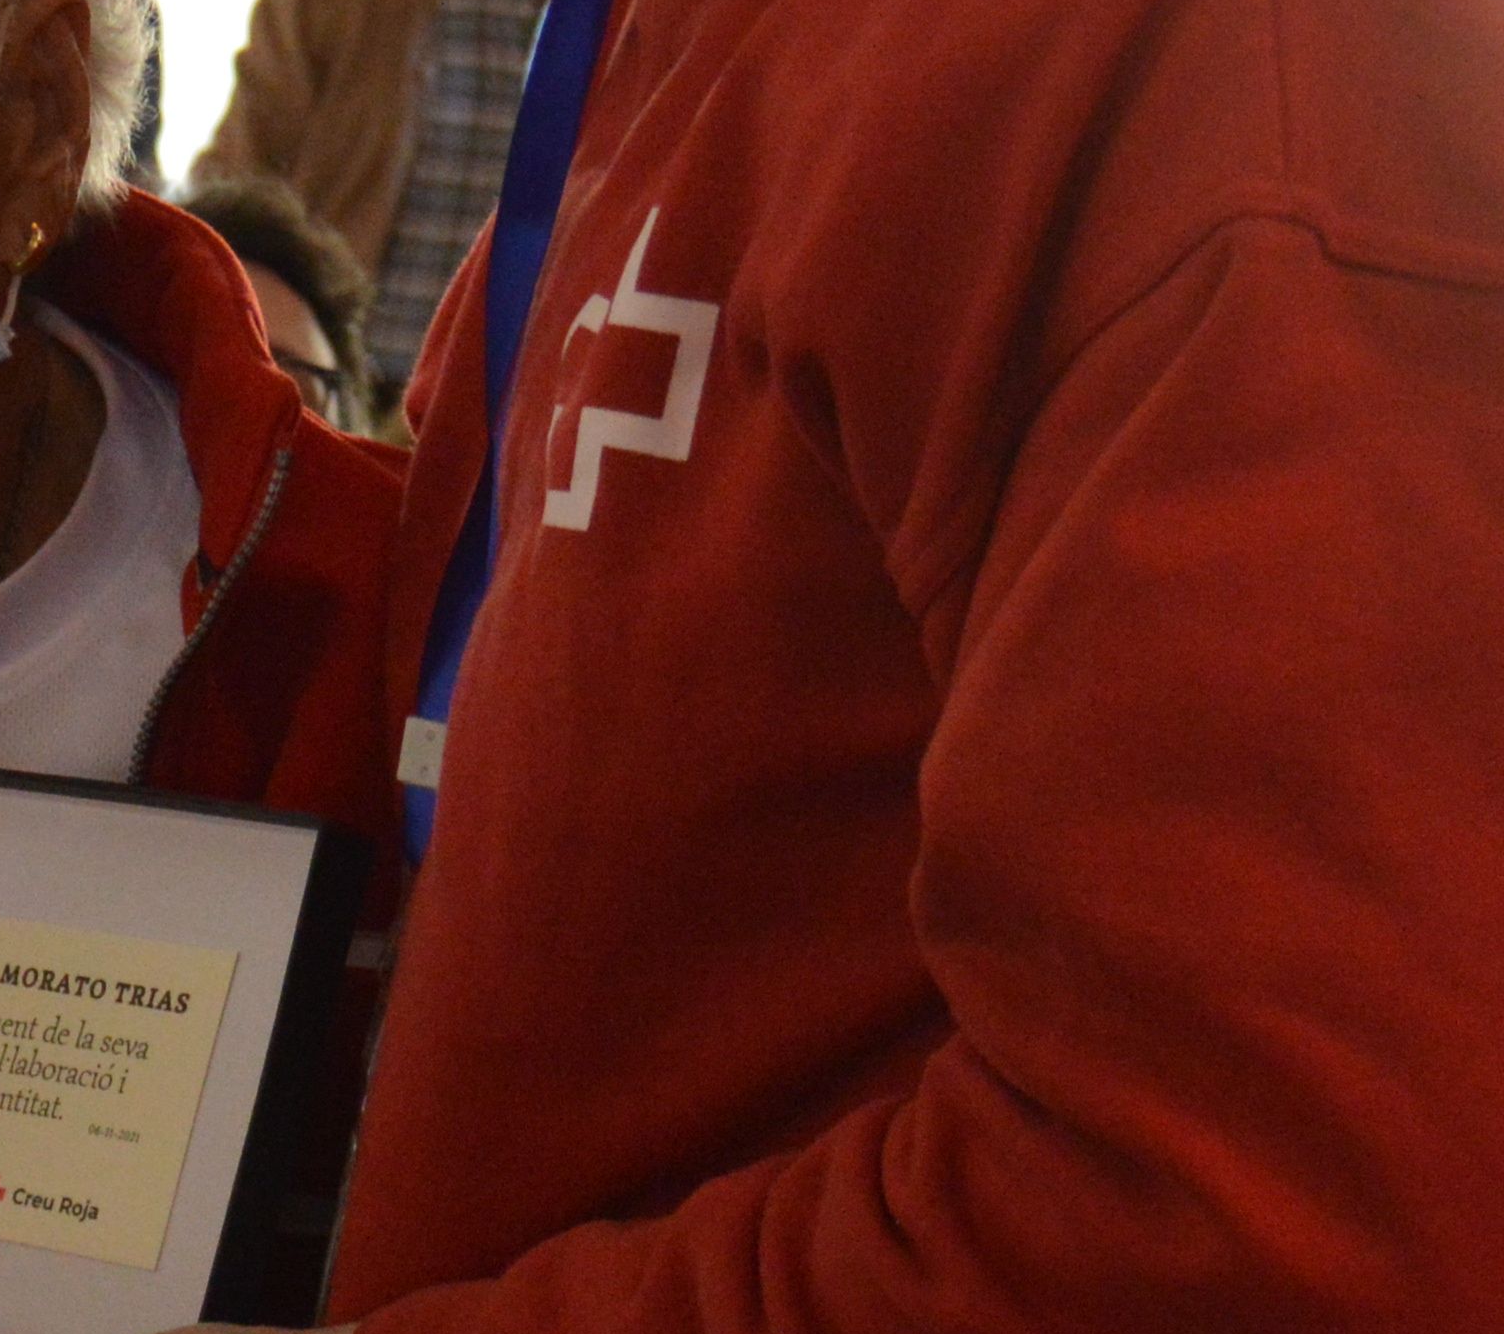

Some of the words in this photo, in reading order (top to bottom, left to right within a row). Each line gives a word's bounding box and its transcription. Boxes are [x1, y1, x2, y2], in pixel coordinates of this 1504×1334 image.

[115, 981, 191, 1014] TRIAS
[43, 1015, 70, 1046] de
[75, 1019, 95, 1050] la
[100, 1034, 150, 1060] seva
[118, 1068, 129, 1094] i
[12, 1188, 55, 1211] Creu
[58, 1196, 100, 1222] Roja
